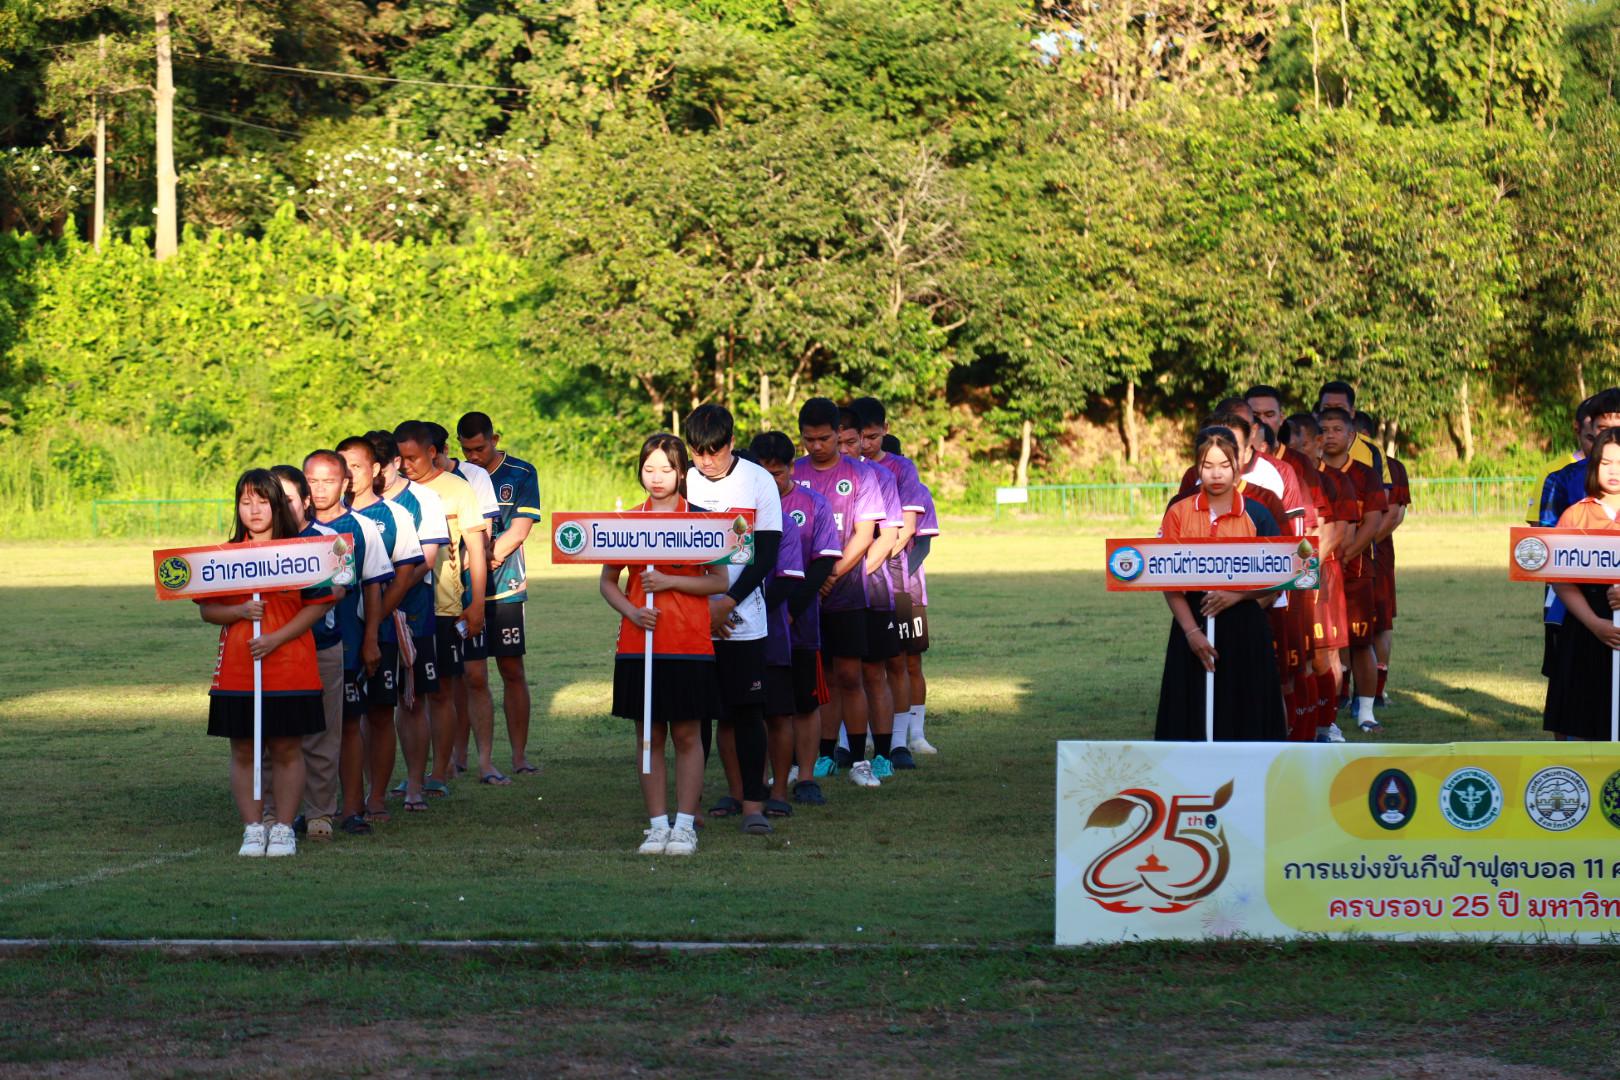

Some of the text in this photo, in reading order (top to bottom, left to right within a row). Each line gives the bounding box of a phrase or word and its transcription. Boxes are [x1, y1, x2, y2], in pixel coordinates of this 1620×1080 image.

[592, 522, 725, 549] โรงพยาบาลแม่สอด
[201, 553, 321, 583] อำเภอแม่สอด
[1148, 549, 1292, 580] สถานีตำรวจภูธรแม่สอด
[501, 627, 520, 645] 33
[1187, 815, 1203, 827] th
[1083, 787, 1231, 902] 25
[1283, 854, 1576, 887] การแข่งขันกีฬาฟุตบอล
[1583, 858, 1604, 879] 11
[1329, 890, 1620, 919] ครบรอบ 25 ปี มหาวิท
